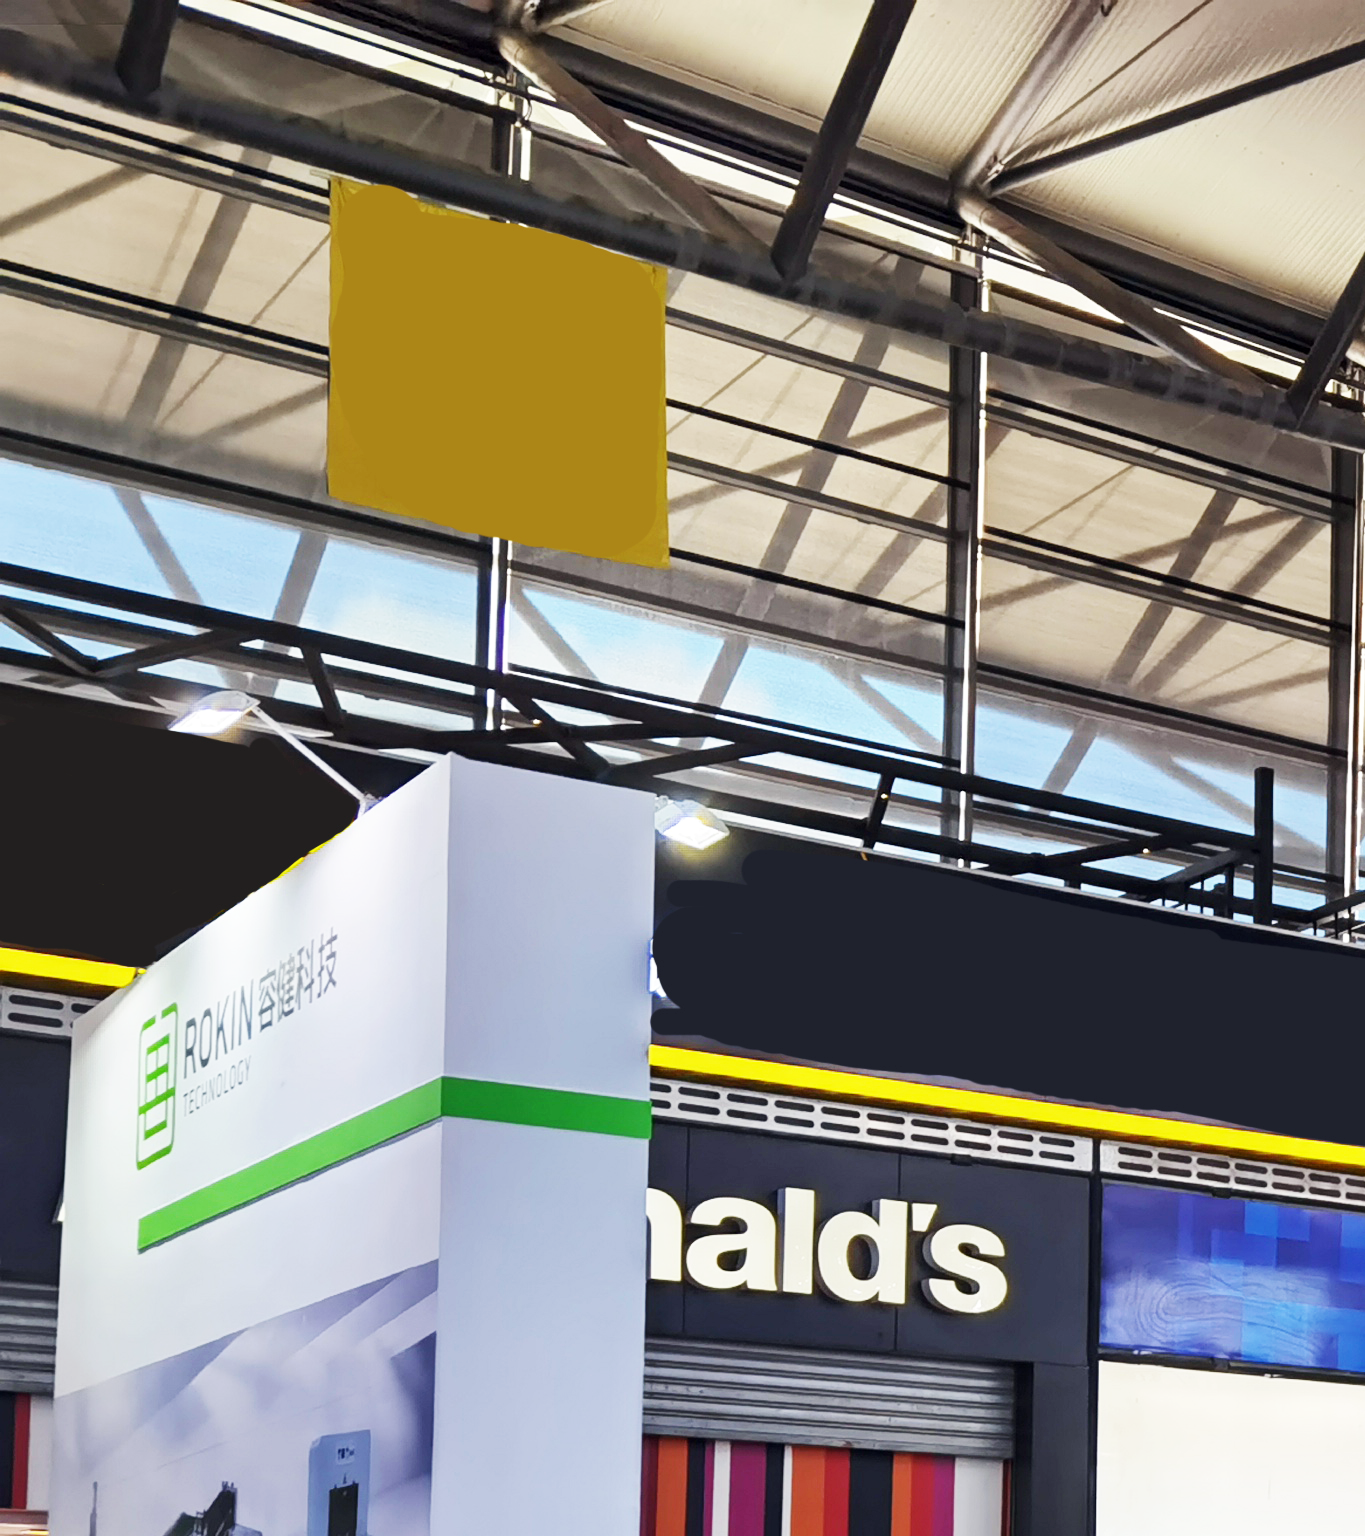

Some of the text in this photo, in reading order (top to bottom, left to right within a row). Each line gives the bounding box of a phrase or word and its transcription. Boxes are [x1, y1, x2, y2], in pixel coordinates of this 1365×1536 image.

[183, 926, 338, 1080] ROKIN 容健科技
[183, 1054, 252, 1117] TECHNOLOGY
